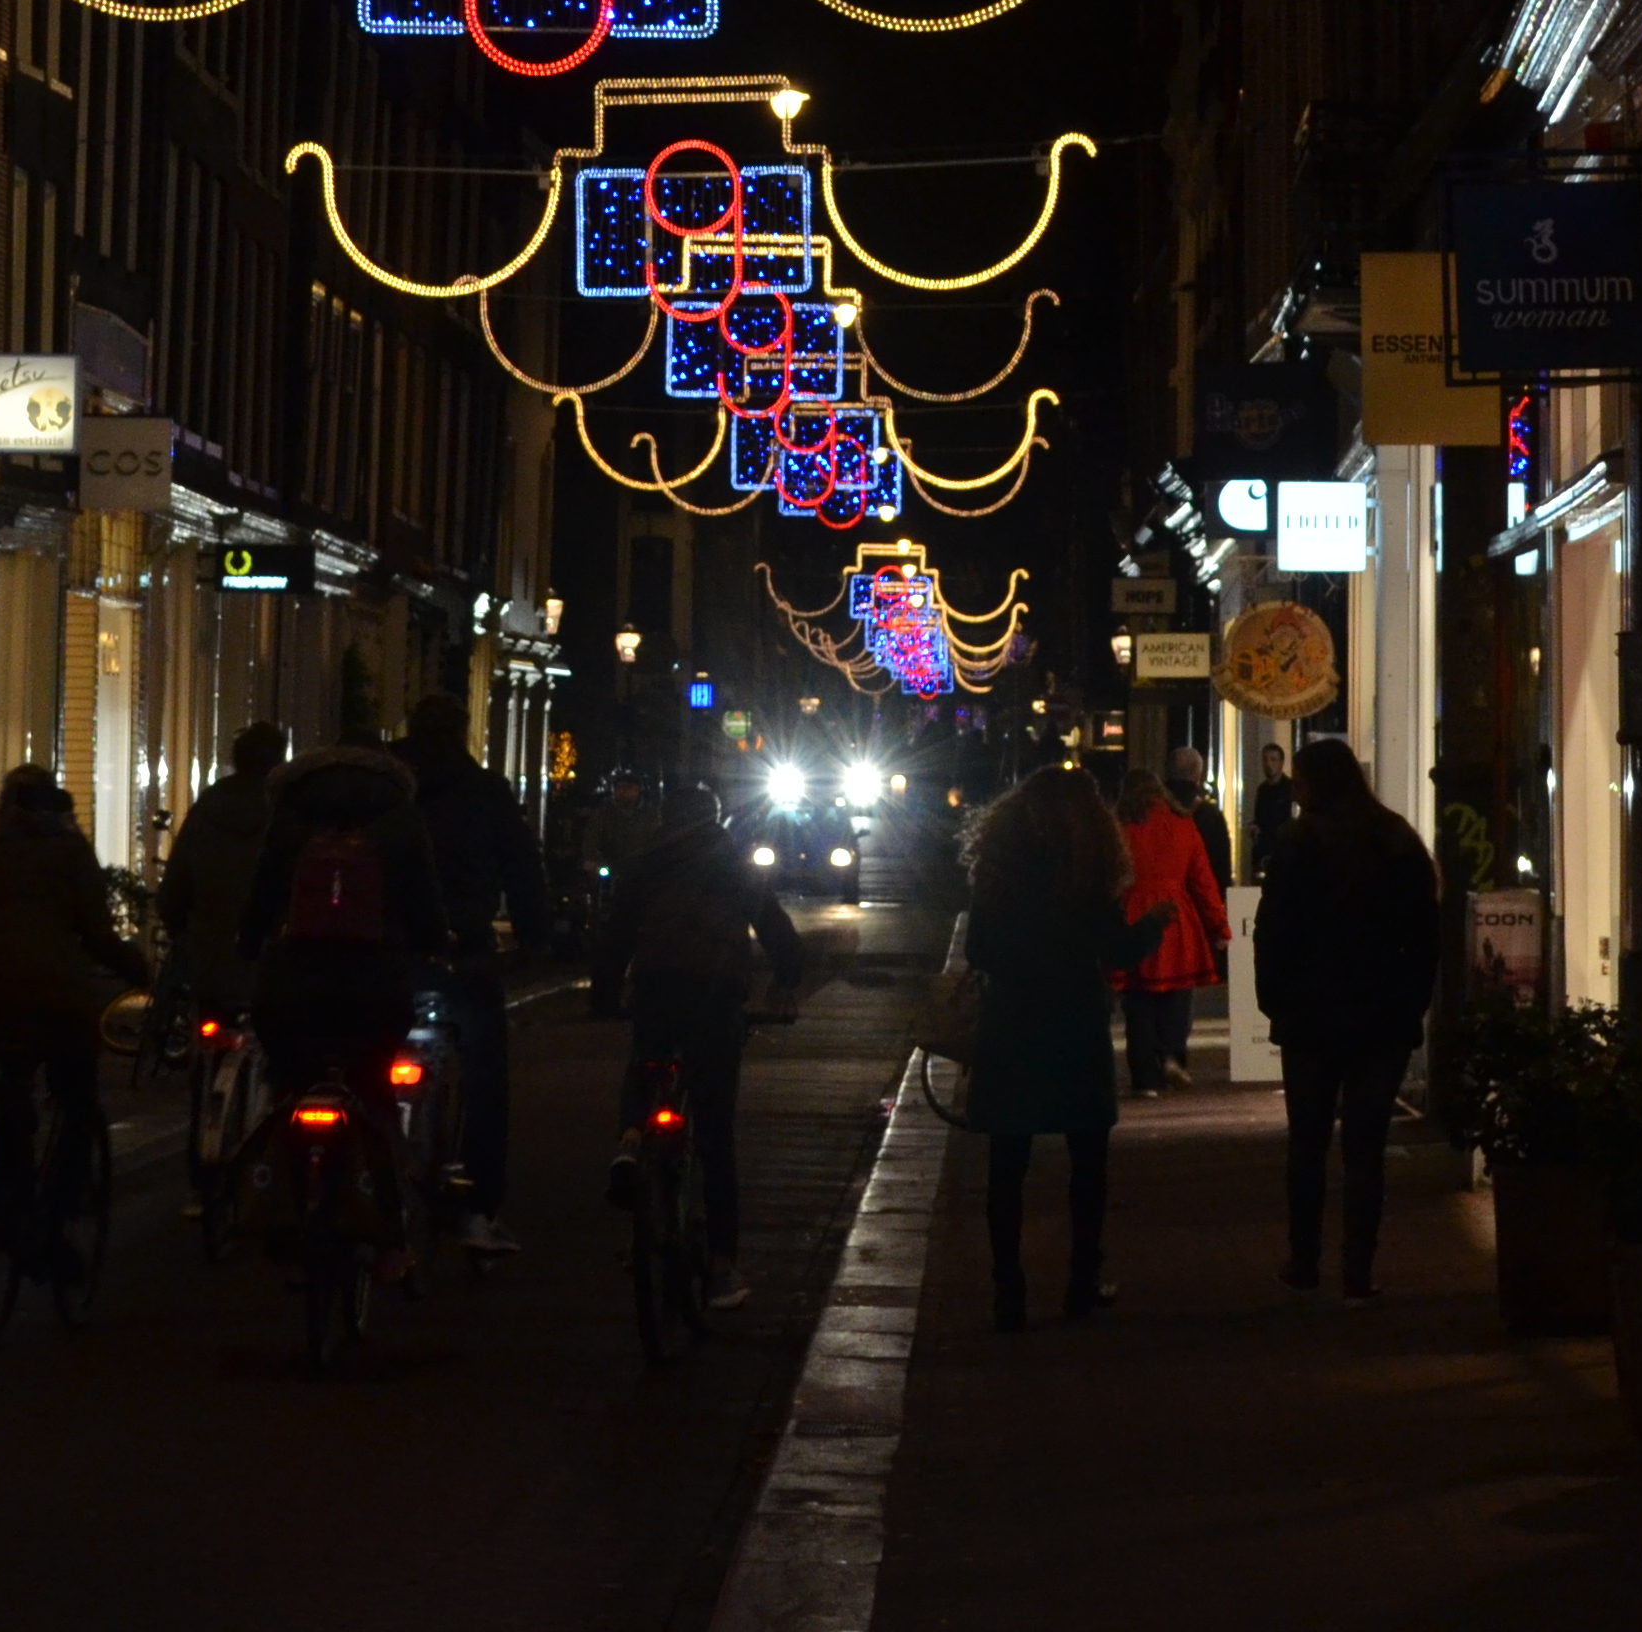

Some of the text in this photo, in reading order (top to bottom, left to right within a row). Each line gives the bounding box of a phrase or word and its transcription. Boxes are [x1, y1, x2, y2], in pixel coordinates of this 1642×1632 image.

[1476, 276, 1633, 306] summum
[1491, 308, 1611, 331] woman
[87, 449, 163, 476] COS
[1142, 641, 1205, 654] AMERICAN
[1148, 656, 1199, 668] VINTAGE
